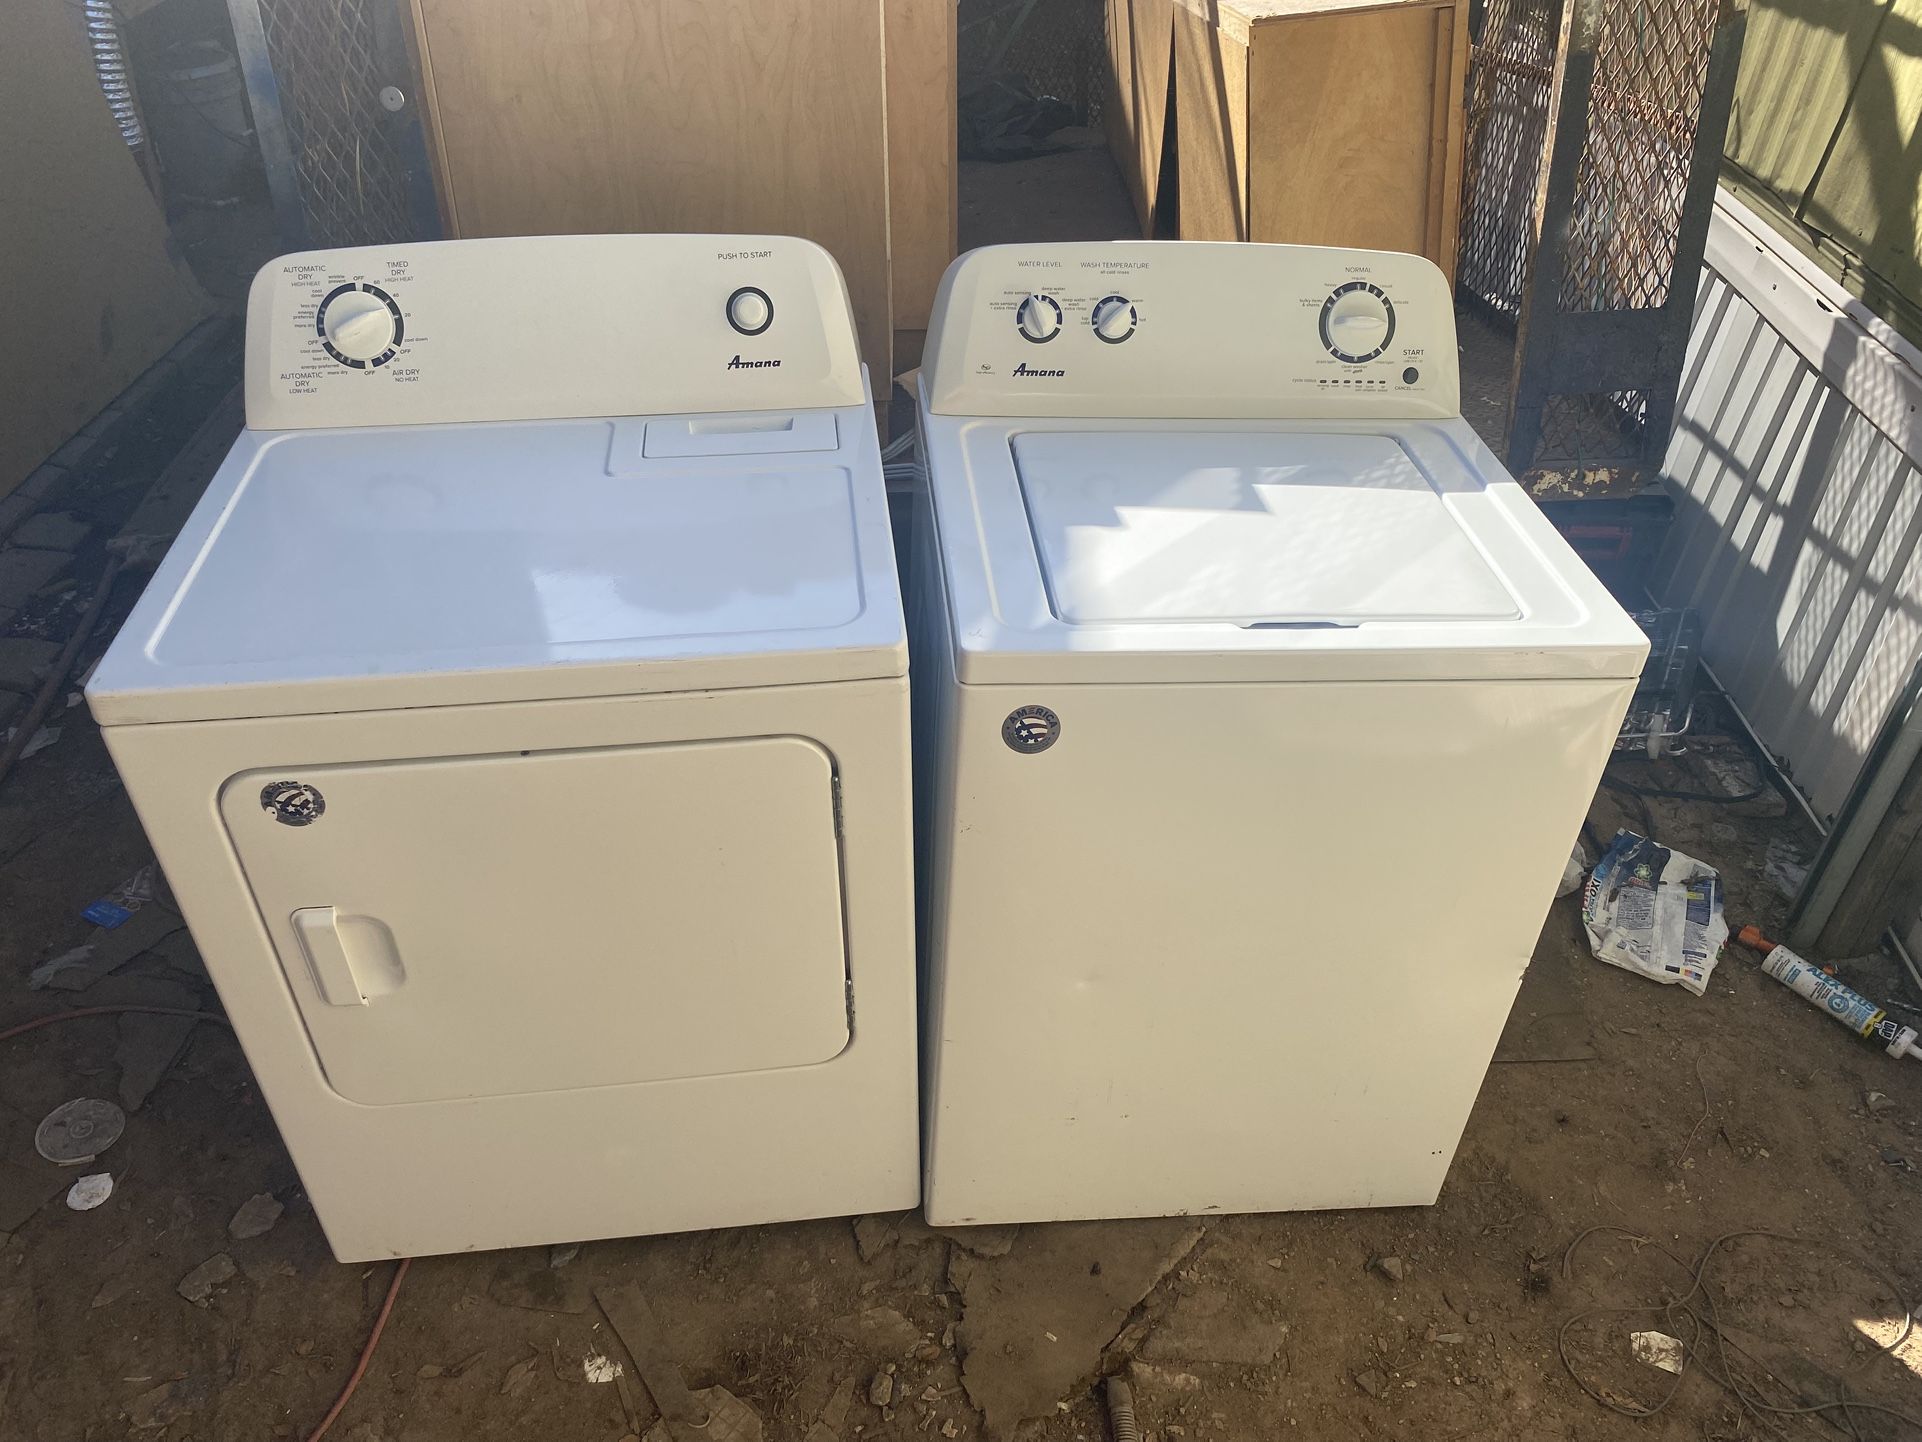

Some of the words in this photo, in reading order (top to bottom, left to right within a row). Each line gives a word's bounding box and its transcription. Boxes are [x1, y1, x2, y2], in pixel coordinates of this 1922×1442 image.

[727, 355, 781, 370] Amana
[1013, 363, 1065, 377] Amana
[1009, 708, 1057, 728] AMERICA
[1590, 877, 1601, 897] OXI
[1807, 966, 1841, 990] ALEX
[1841, 988, 1875, 1012] PLUS
[1882, 1022, 1894, 1038] DAP
